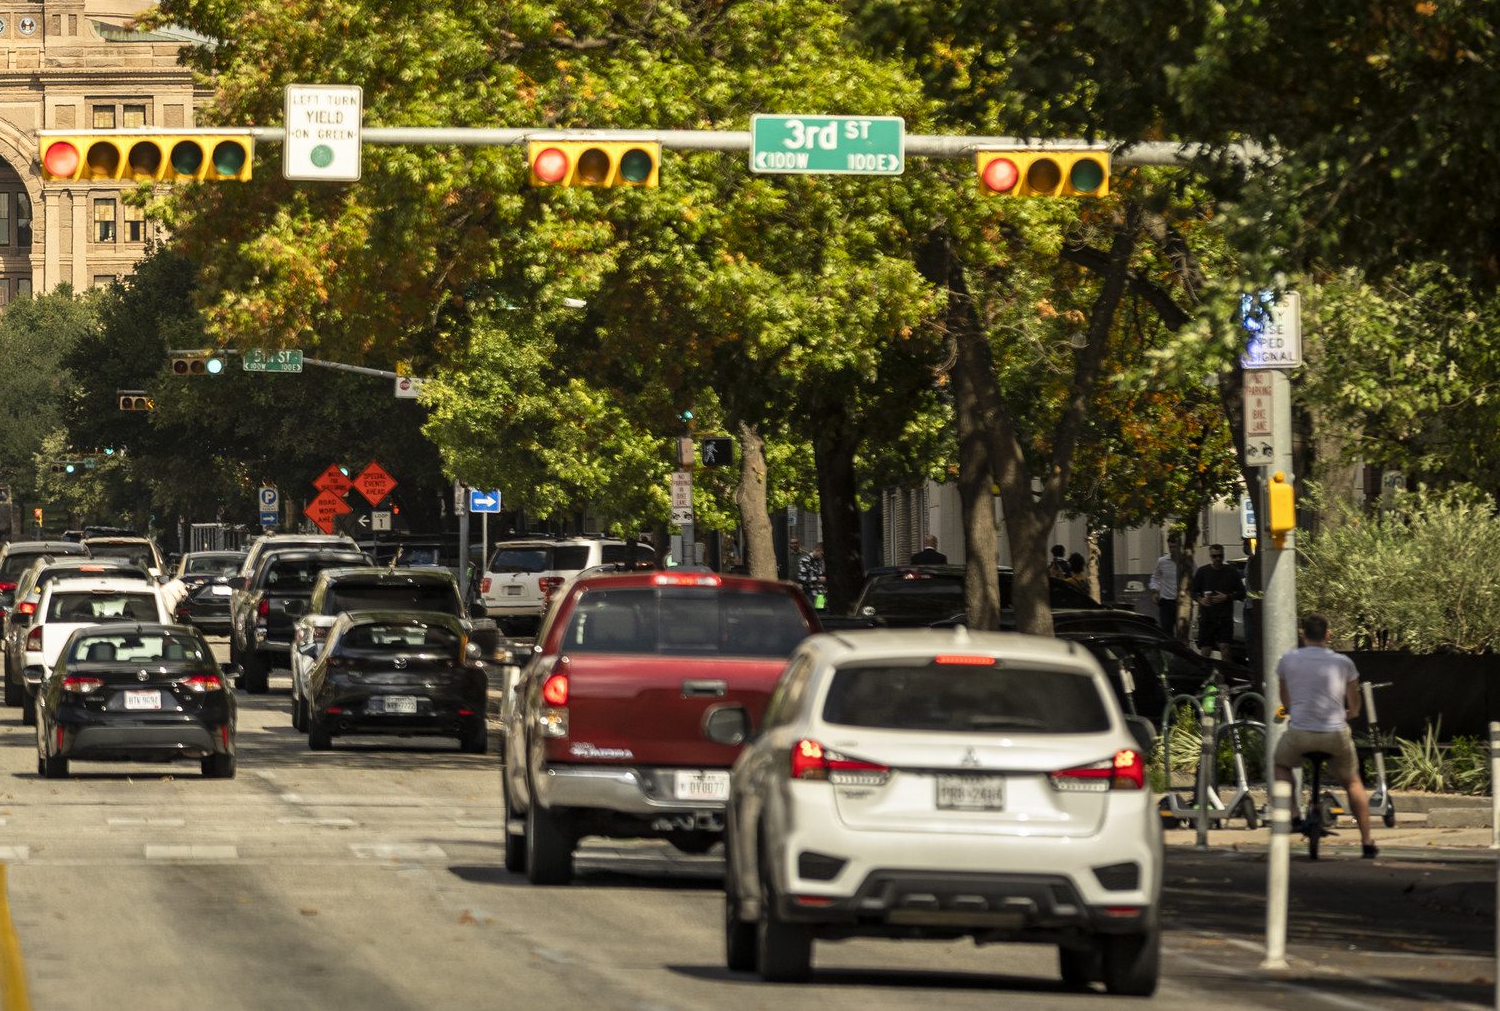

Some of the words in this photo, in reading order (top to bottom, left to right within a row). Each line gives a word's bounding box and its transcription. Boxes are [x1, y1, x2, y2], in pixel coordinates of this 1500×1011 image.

[293, 94, 319, 105] LEFT
[328, 95, 357, 106] TURN
[306, 110, 344, 124] YIELD
[295, 129, 309, 139] ON
[318, 130, 354, 140] GREEN
[783, 119, 838, 150] 3rd
[844, 120, 872, 139] ST
[767, 151, 809, 169] 100W
[847, 153, 888, 170] 100E
[278, 350, 291, 363] ST
